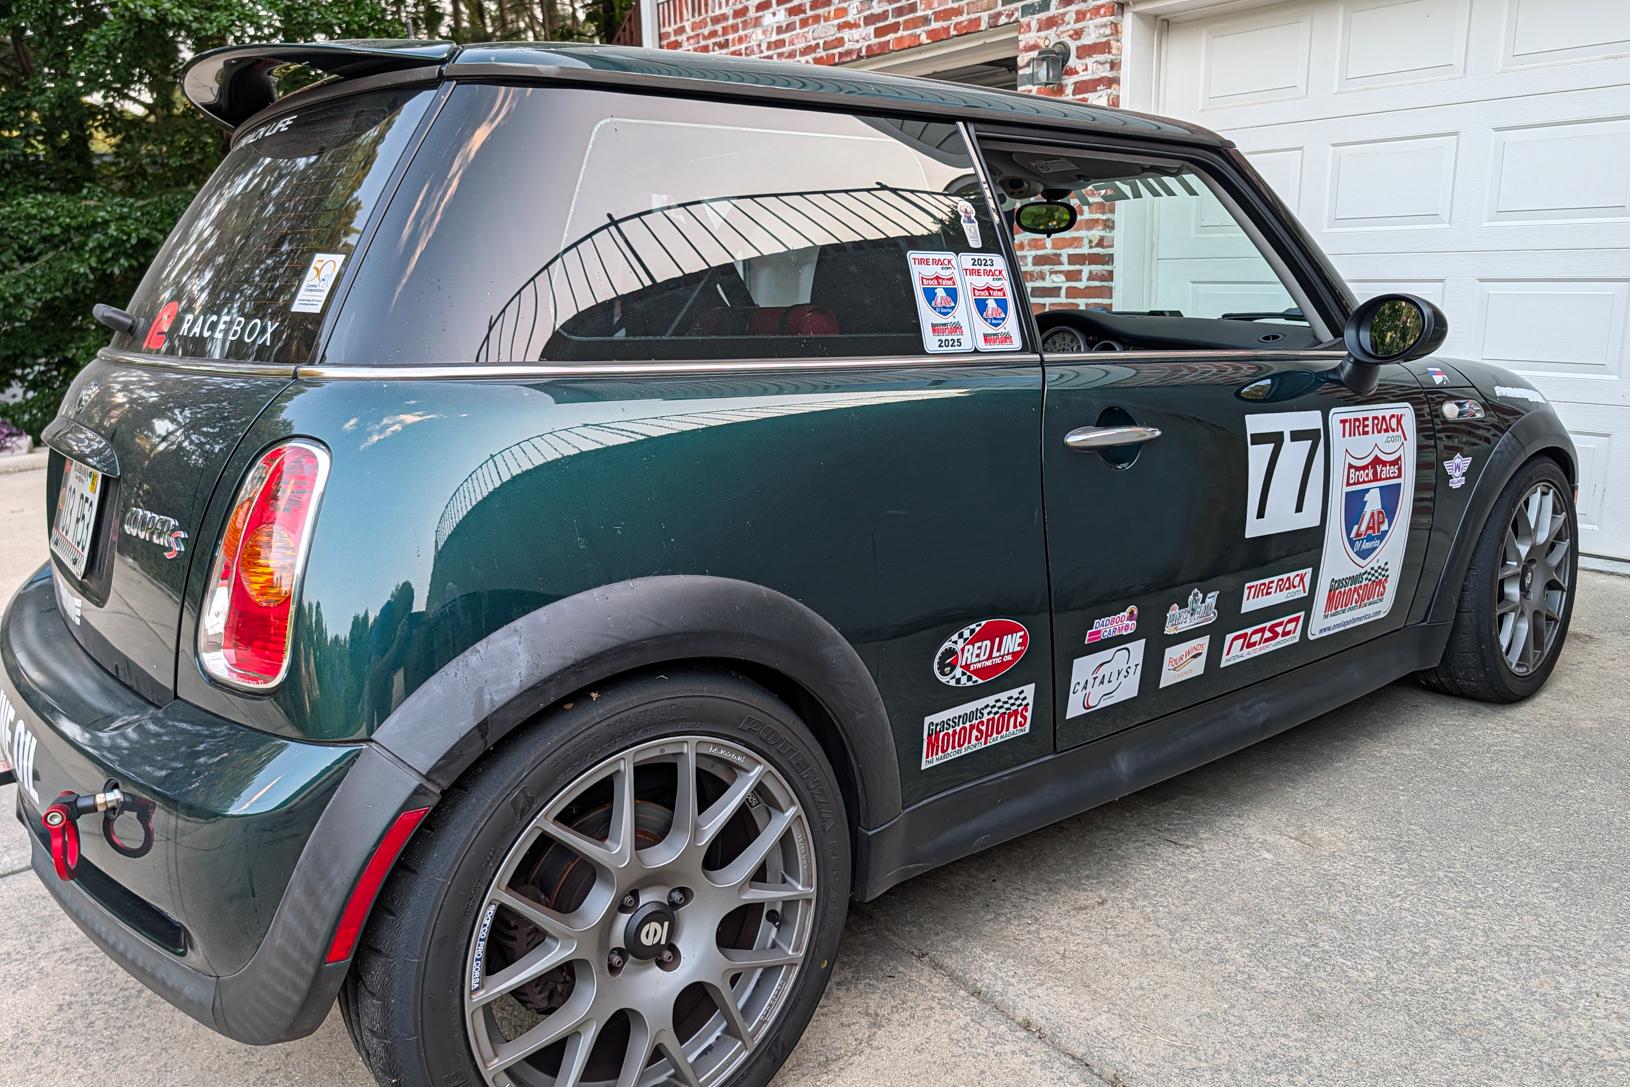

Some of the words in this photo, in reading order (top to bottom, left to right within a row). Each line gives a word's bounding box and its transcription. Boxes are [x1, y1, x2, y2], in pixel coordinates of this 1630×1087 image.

[912, 258, 930, 266] TIRE
[932, 258, 955, 270] RACK
[963, 268, 982, 276] TIRE
[983, 269, 1006, 281] RACK
[971, 258, 994, 266] 2023
[179, 314, 280, 346] RACEBOX
[938, 338, 962, 348] 2025
[1339, 417, 1370, 438] TIRE
[1371, 414, 1407, 441] RACK
[1384, 435, 1402, 444] .com
[1250, 428, 1321, 520] 77
[1349, 464, 1374, 484] Brock
[124, 507, 179, 547] COOPER
[163, 530, 188, 559] S
[1353, 509, 1386, 540] LAP
[1246, 580, 1275, 601] TIRE
[1274, 571, 1308, 594] RACK
[1284, 589, 1302, 599] .com
[1324, 577, 1389, 614] Motorsports
[1329, 572, 1364, 592] Grassroots
[1095, 614, 1126, 629] DADBOD
[961, 640, 991, 666] RED
[992, 631, 1025, 658] LINE
[969, 656, 1003, 671] SYNTHETIC
[1003, 654, 1013, 662] OIL
[1072, 663, 1140, 695] CATALYST
[925, 705, 1029, 760] Motorsports
[927, 707, 986, 736] Grassroots
[925, 758, 935, 767] THE
[935, 748, 963, 762] HARDCORE
[963, 741, 983, 753] SPORTS
[988, 735, 999, 744] CAR
[999, 726, 1027, 741] MAGAZINE
[13, 719, 40, 805] OIL
[471, 960, 481, 991] CORSA
